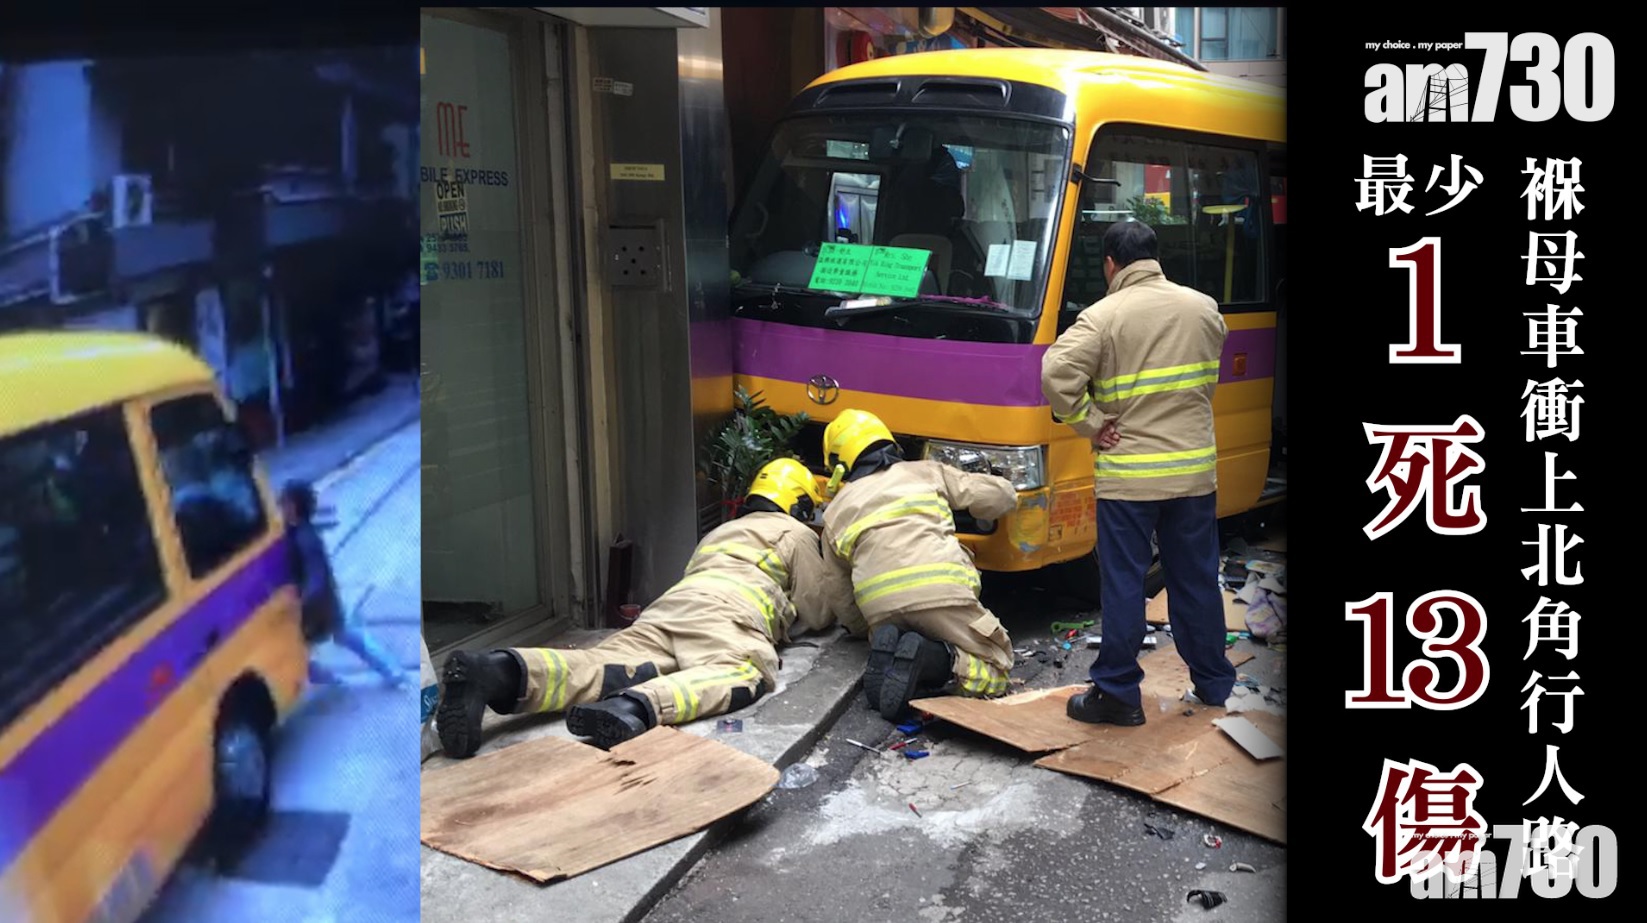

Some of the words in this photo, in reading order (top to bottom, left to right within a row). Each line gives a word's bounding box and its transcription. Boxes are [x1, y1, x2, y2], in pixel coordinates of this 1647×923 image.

[455, 168, 509, 187] EXPRESS
[436, 181, 465, 200] OPEN
[440, 213, 468, 233] PUSH
[443, 260, 473, 280] 9301
[477, 260, 505, 280] 7181
